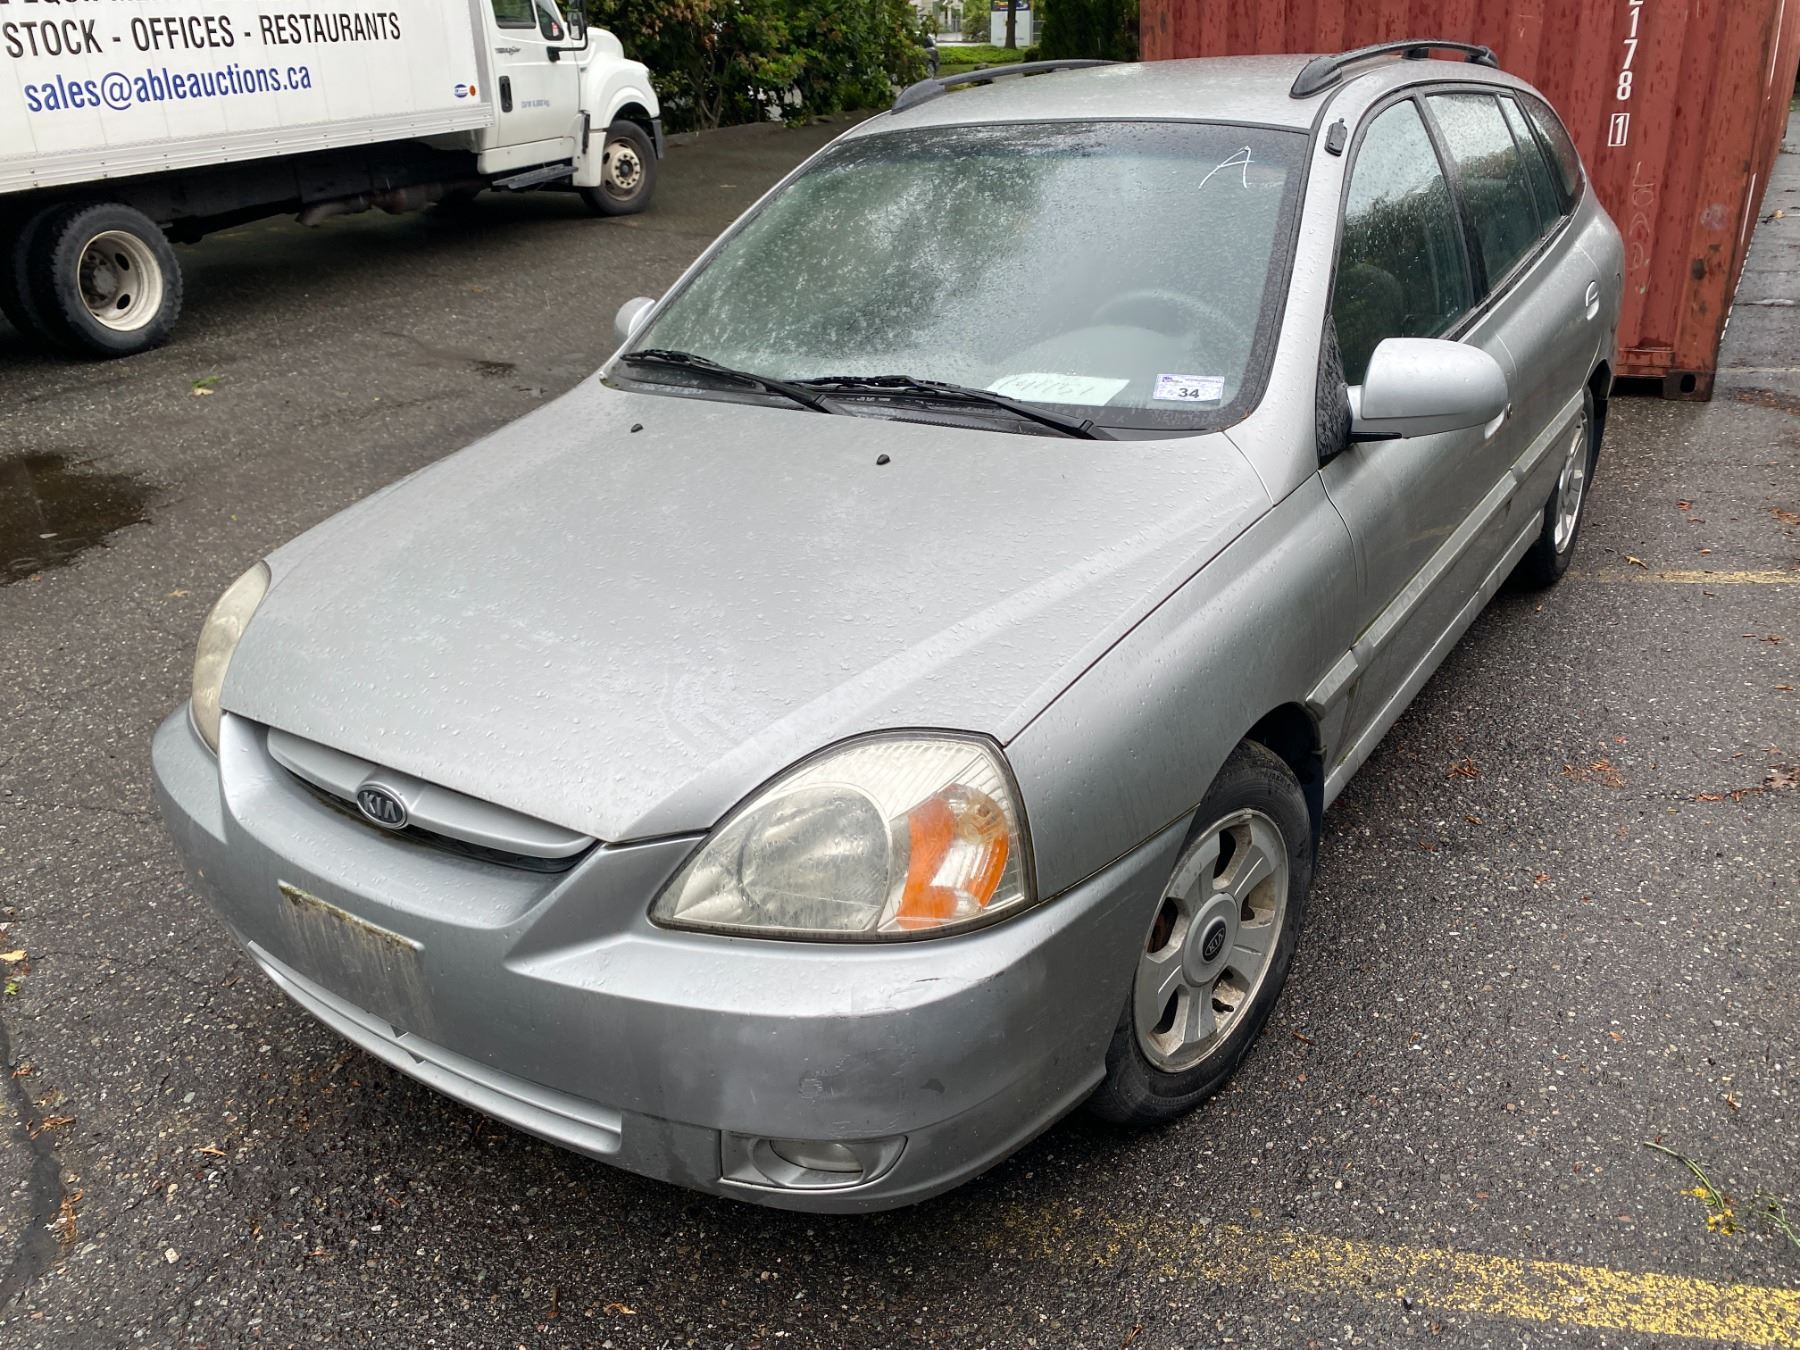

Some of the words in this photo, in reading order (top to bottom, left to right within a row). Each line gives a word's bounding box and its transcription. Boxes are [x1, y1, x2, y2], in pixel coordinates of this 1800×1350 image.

[1, 18, 103, 59] STOCK
[130, 14, 236, 52] OFFICES
[259, 11, 402, 46] RESTAURANTS
[24, 63, 312, 113] sales@ableauctions.ca
[1178, 387, 1200, 399] 34
[362, 791, 398, 822] KIA
